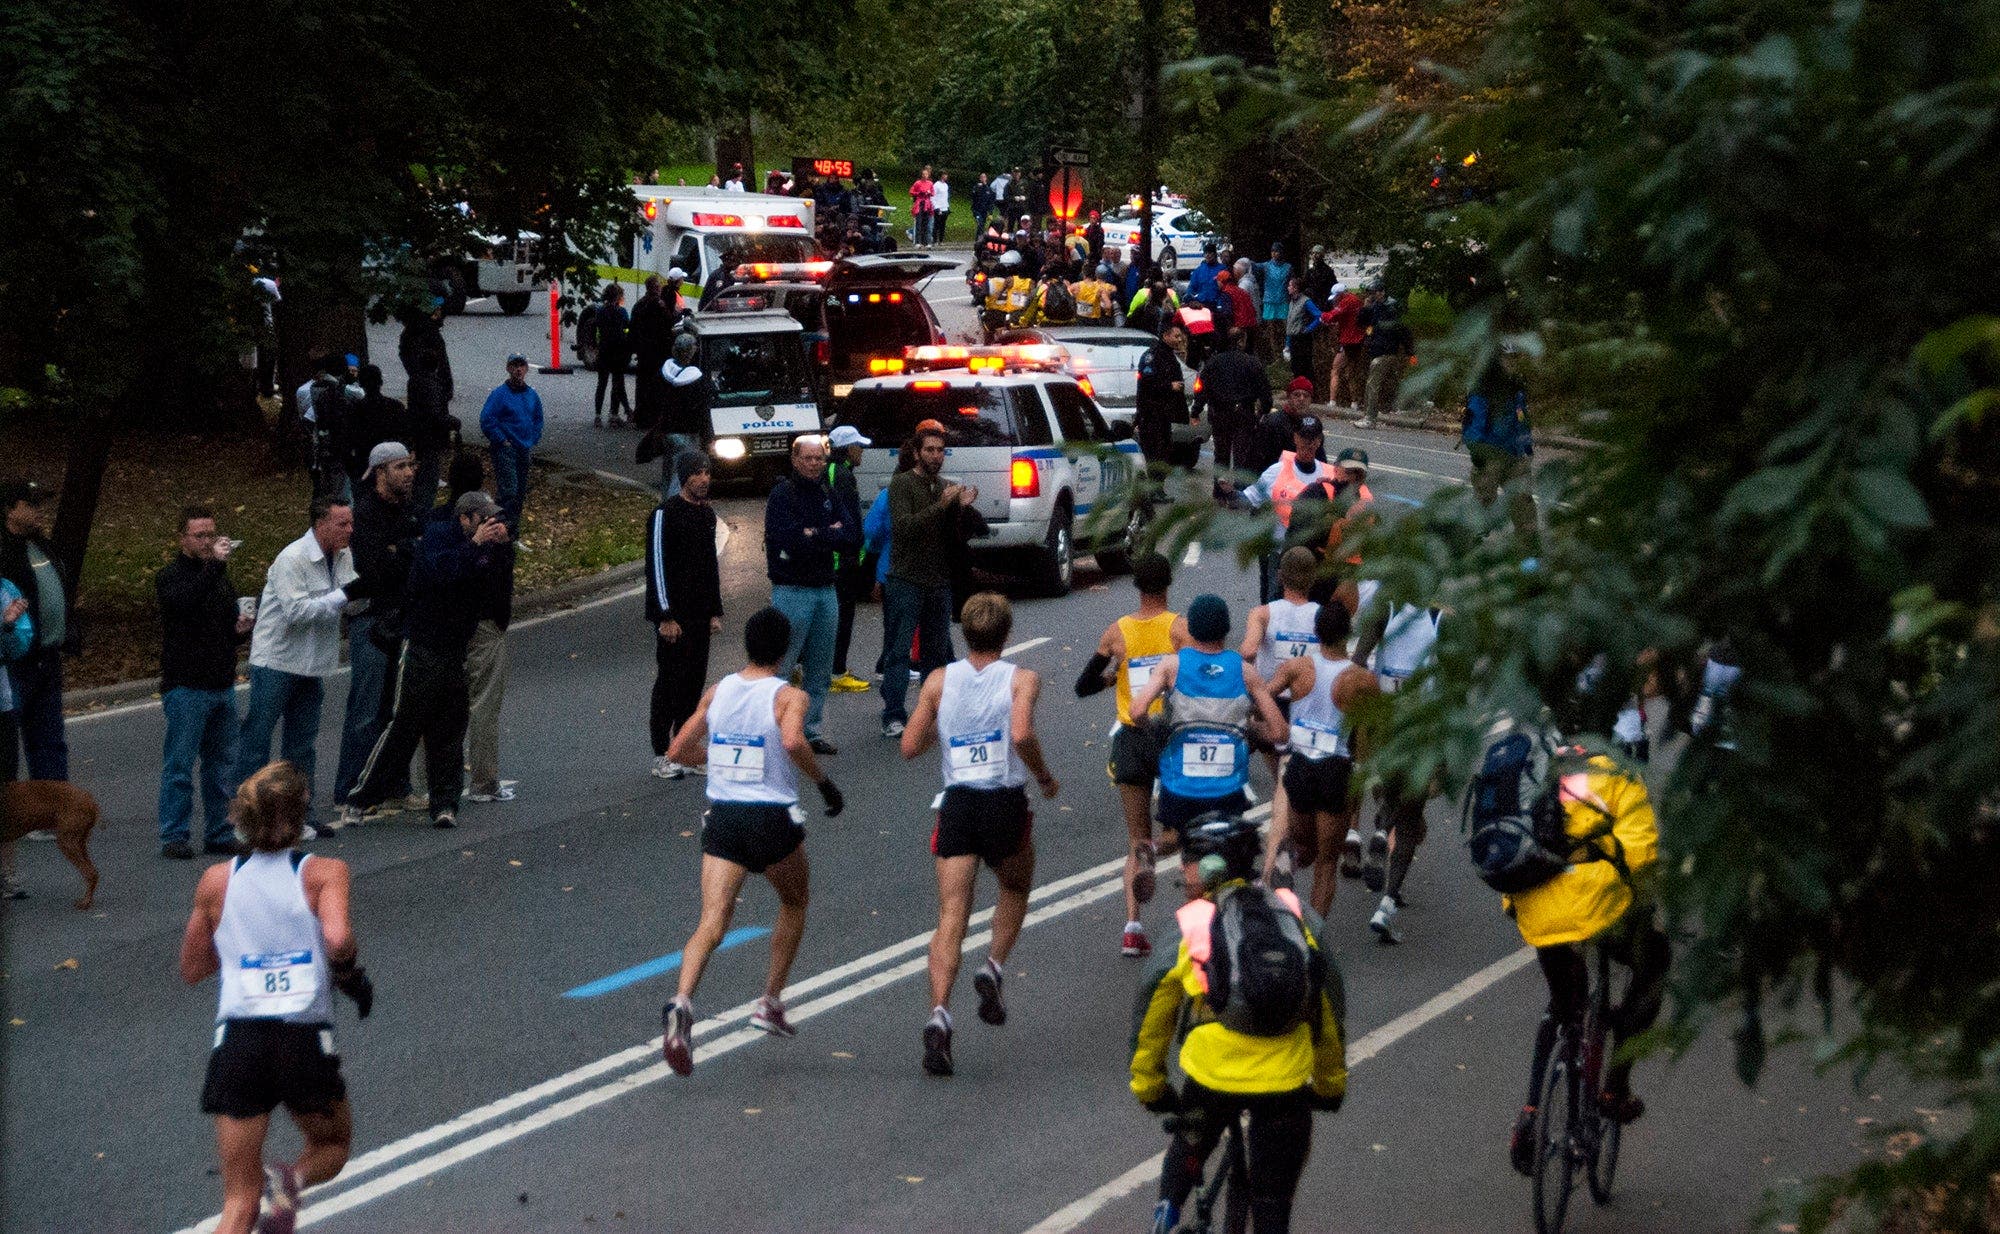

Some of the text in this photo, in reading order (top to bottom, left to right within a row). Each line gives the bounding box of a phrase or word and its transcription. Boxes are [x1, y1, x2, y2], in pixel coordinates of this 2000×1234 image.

[814, 160, 851, 176] 48:55
[742, 420, 794, 430] POLICE
[1290, 644, 1307, 657] 47
[1311, 731, 1316, 745] 1
[733, 748, 742, 764] 7
[970, 745, 988, 763] 20
[1199, 746, 1217, 762] 87
[265, 971, 290, 993] 85
